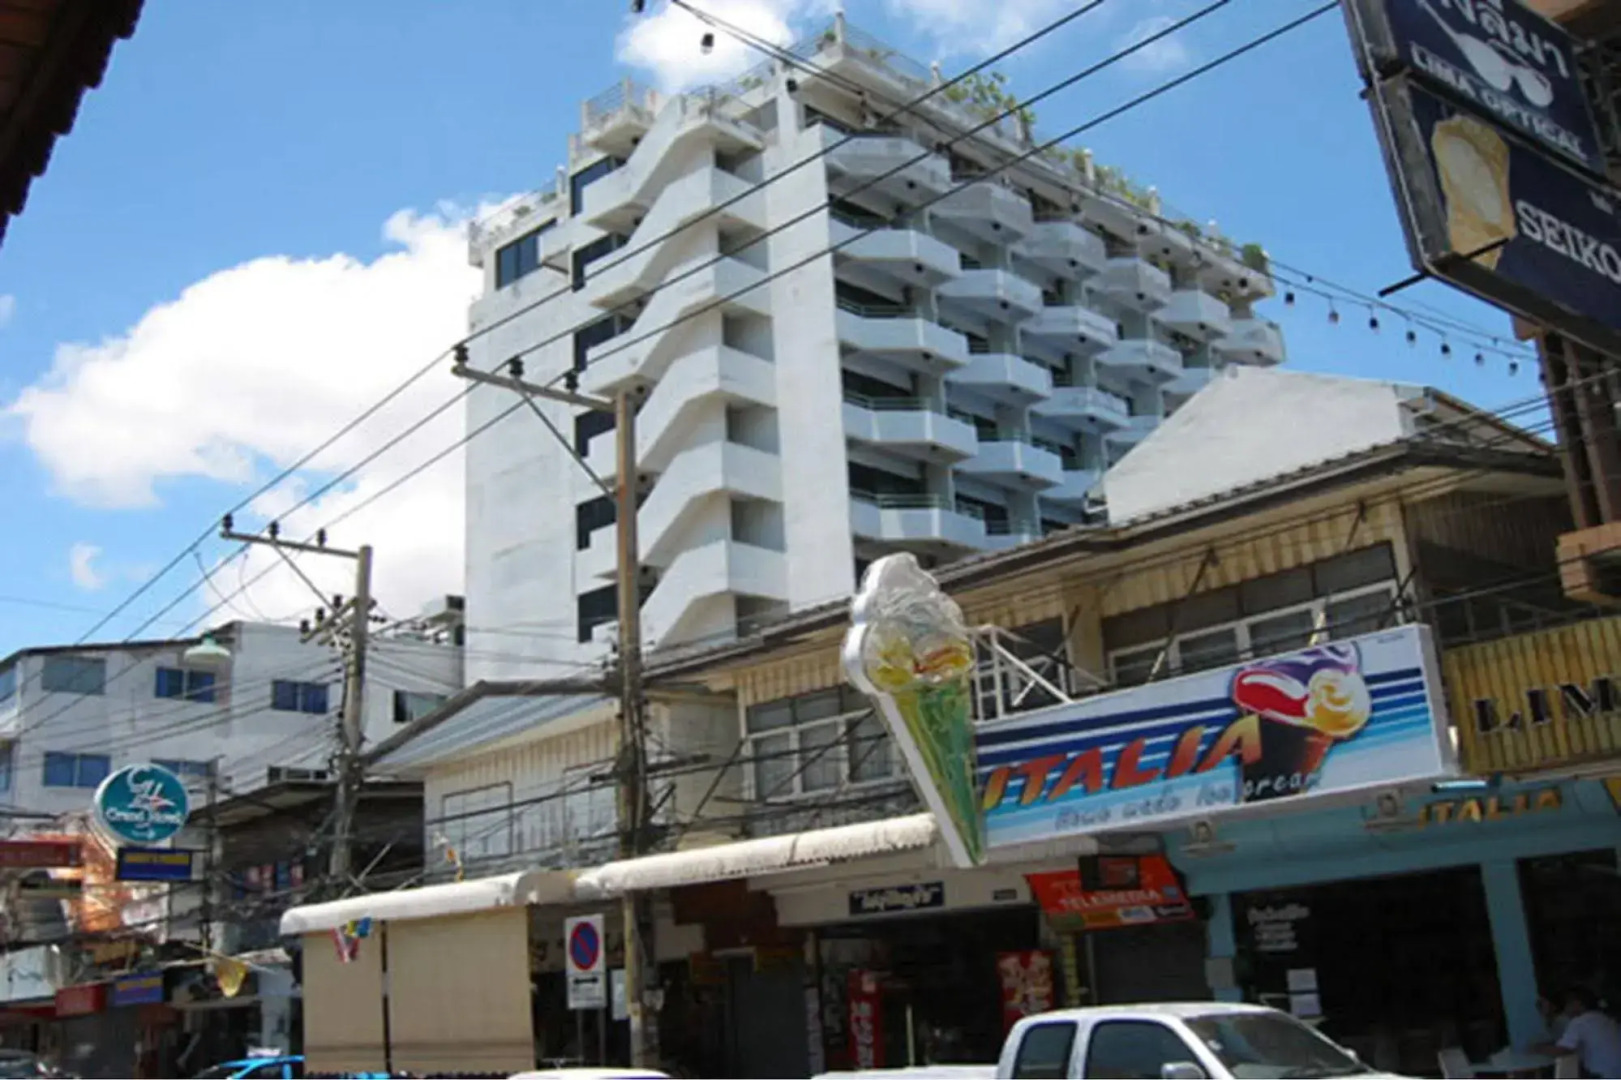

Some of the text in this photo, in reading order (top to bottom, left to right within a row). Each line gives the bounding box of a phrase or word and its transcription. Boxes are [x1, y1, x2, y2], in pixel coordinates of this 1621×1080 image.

[1515, 199, 1621, 284] SEIKO
[984, 713, 1262, 809] ITALIA
[1417, 789, 1561, 829] ITALIA
